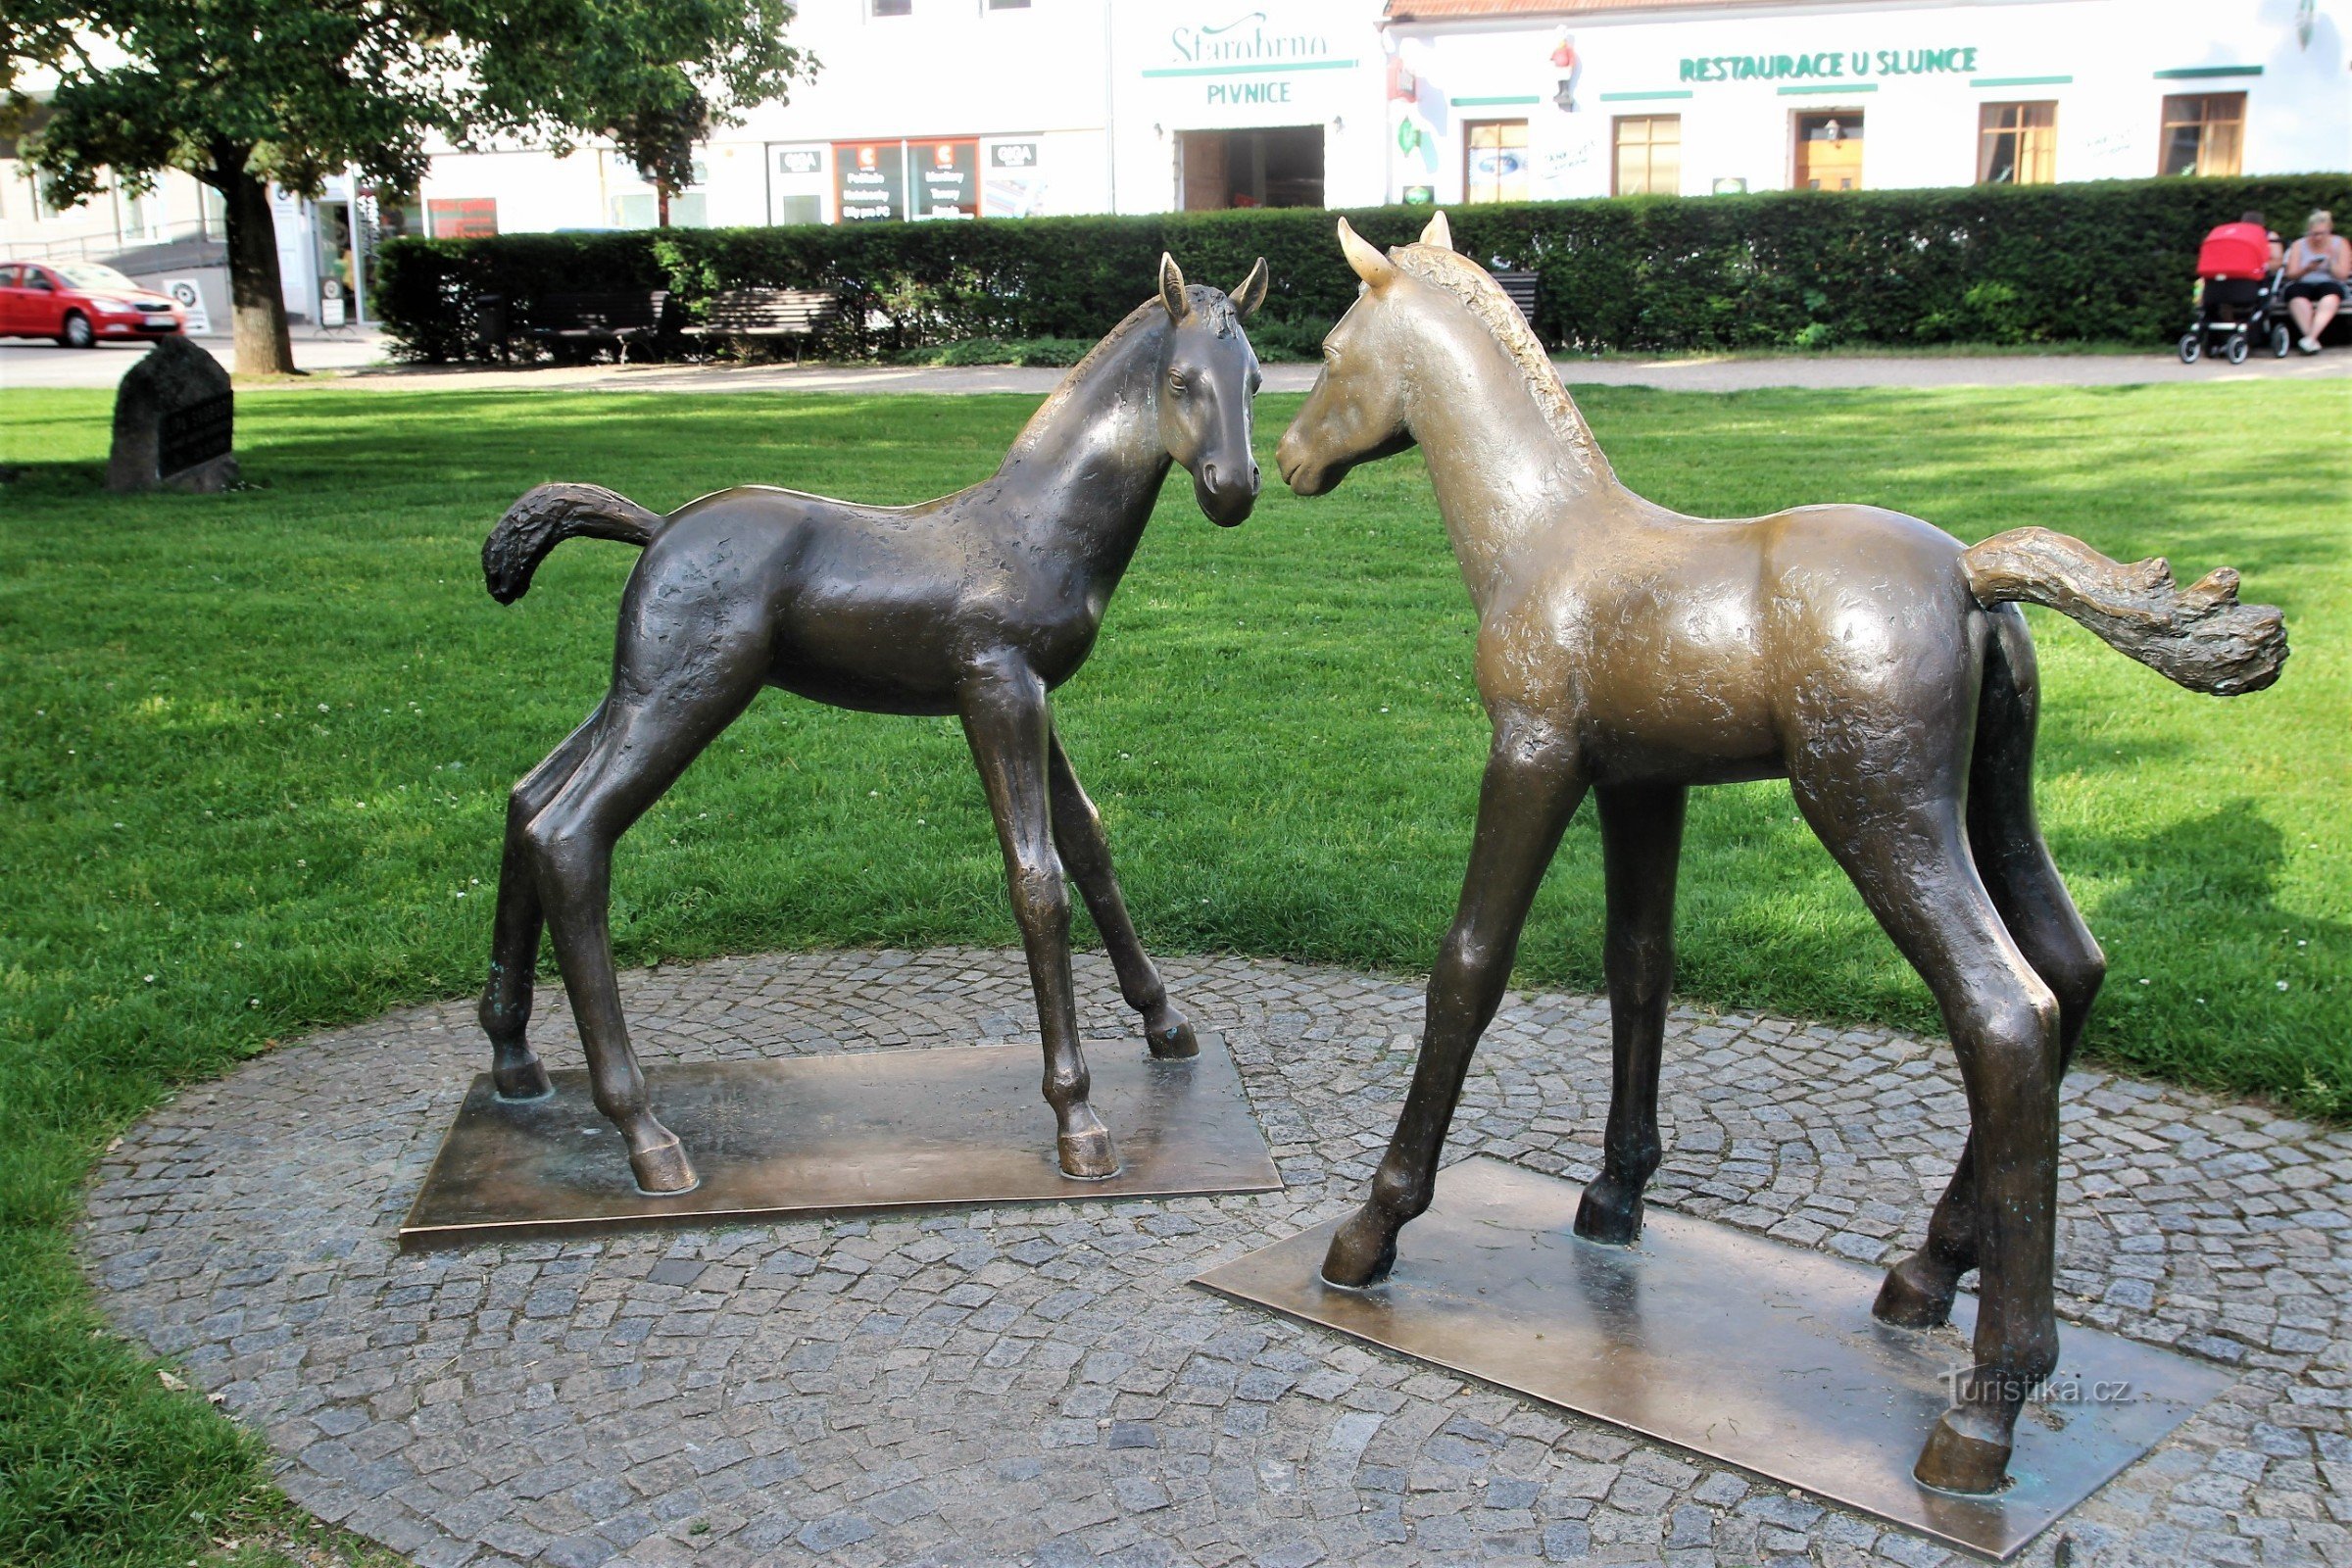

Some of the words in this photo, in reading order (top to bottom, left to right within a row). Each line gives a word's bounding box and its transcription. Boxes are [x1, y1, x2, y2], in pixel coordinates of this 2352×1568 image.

[1680, 53, 1844, 82] RESTAURACE
[1852, 51, 1870, 76] U
[1877, 47, 1978, 76] SLUNCE
[1207, 81, 1292, 105] PIVNICE
